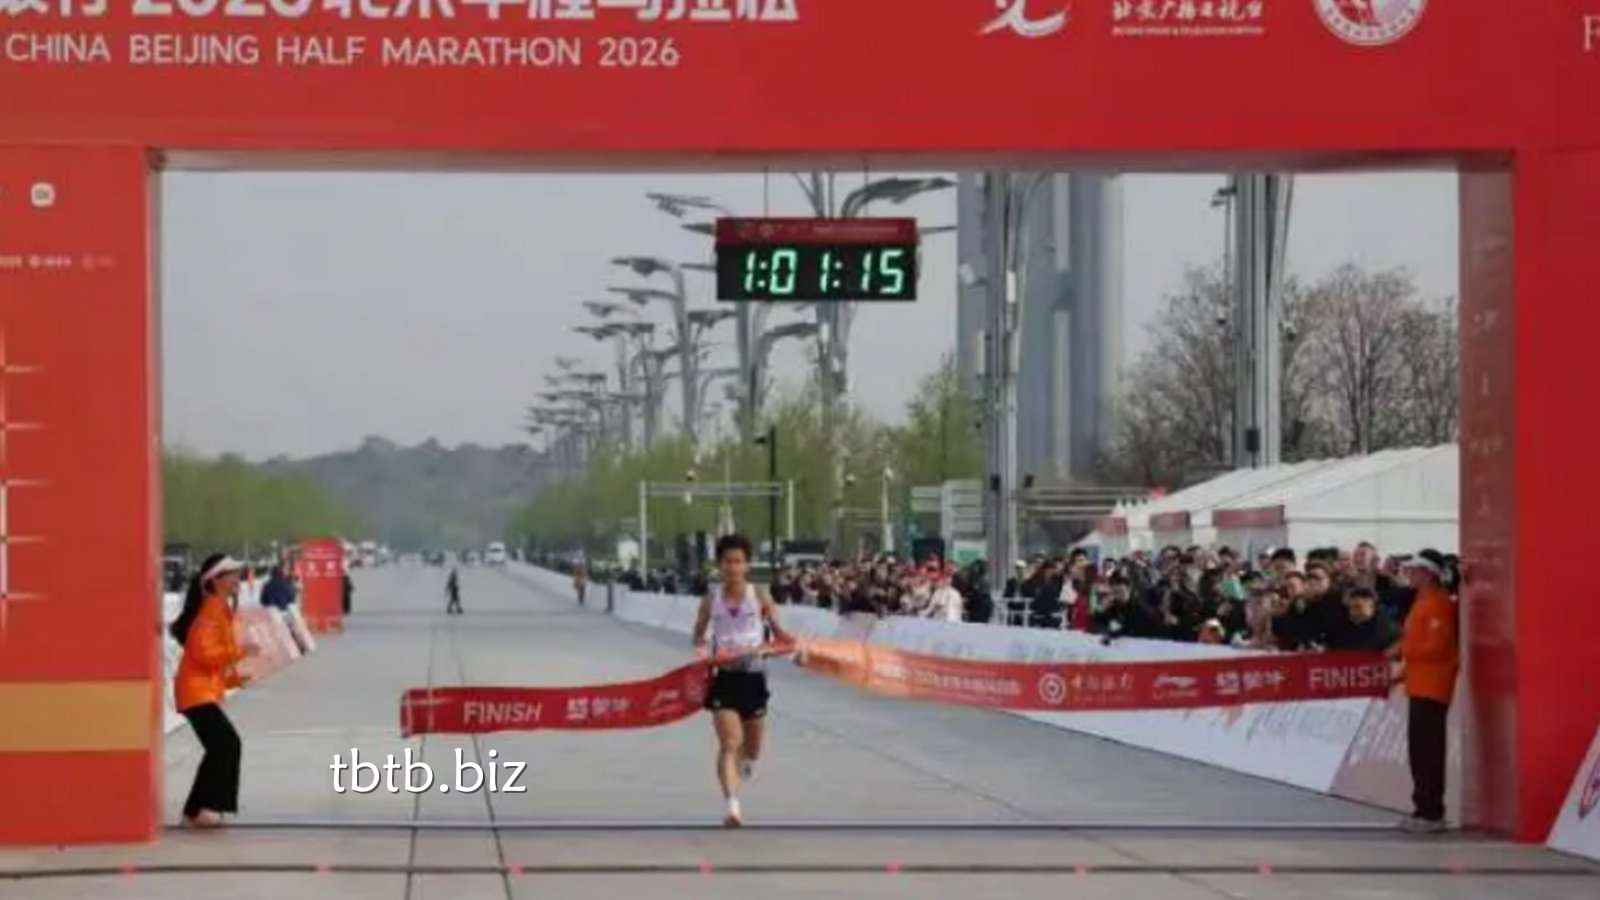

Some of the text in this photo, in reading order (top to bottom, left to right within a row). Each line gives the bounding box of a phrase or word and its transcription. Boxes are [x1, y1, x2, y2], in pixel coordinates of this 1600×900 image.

[5, 34, 680, 67] CHINA BEIJING HALF MARATHON 2026
[744, 249, 904, 294] 1:01:15
[1308, 665, 1390, 691] FINISH
[462, 700, 543, 725] FINISH
